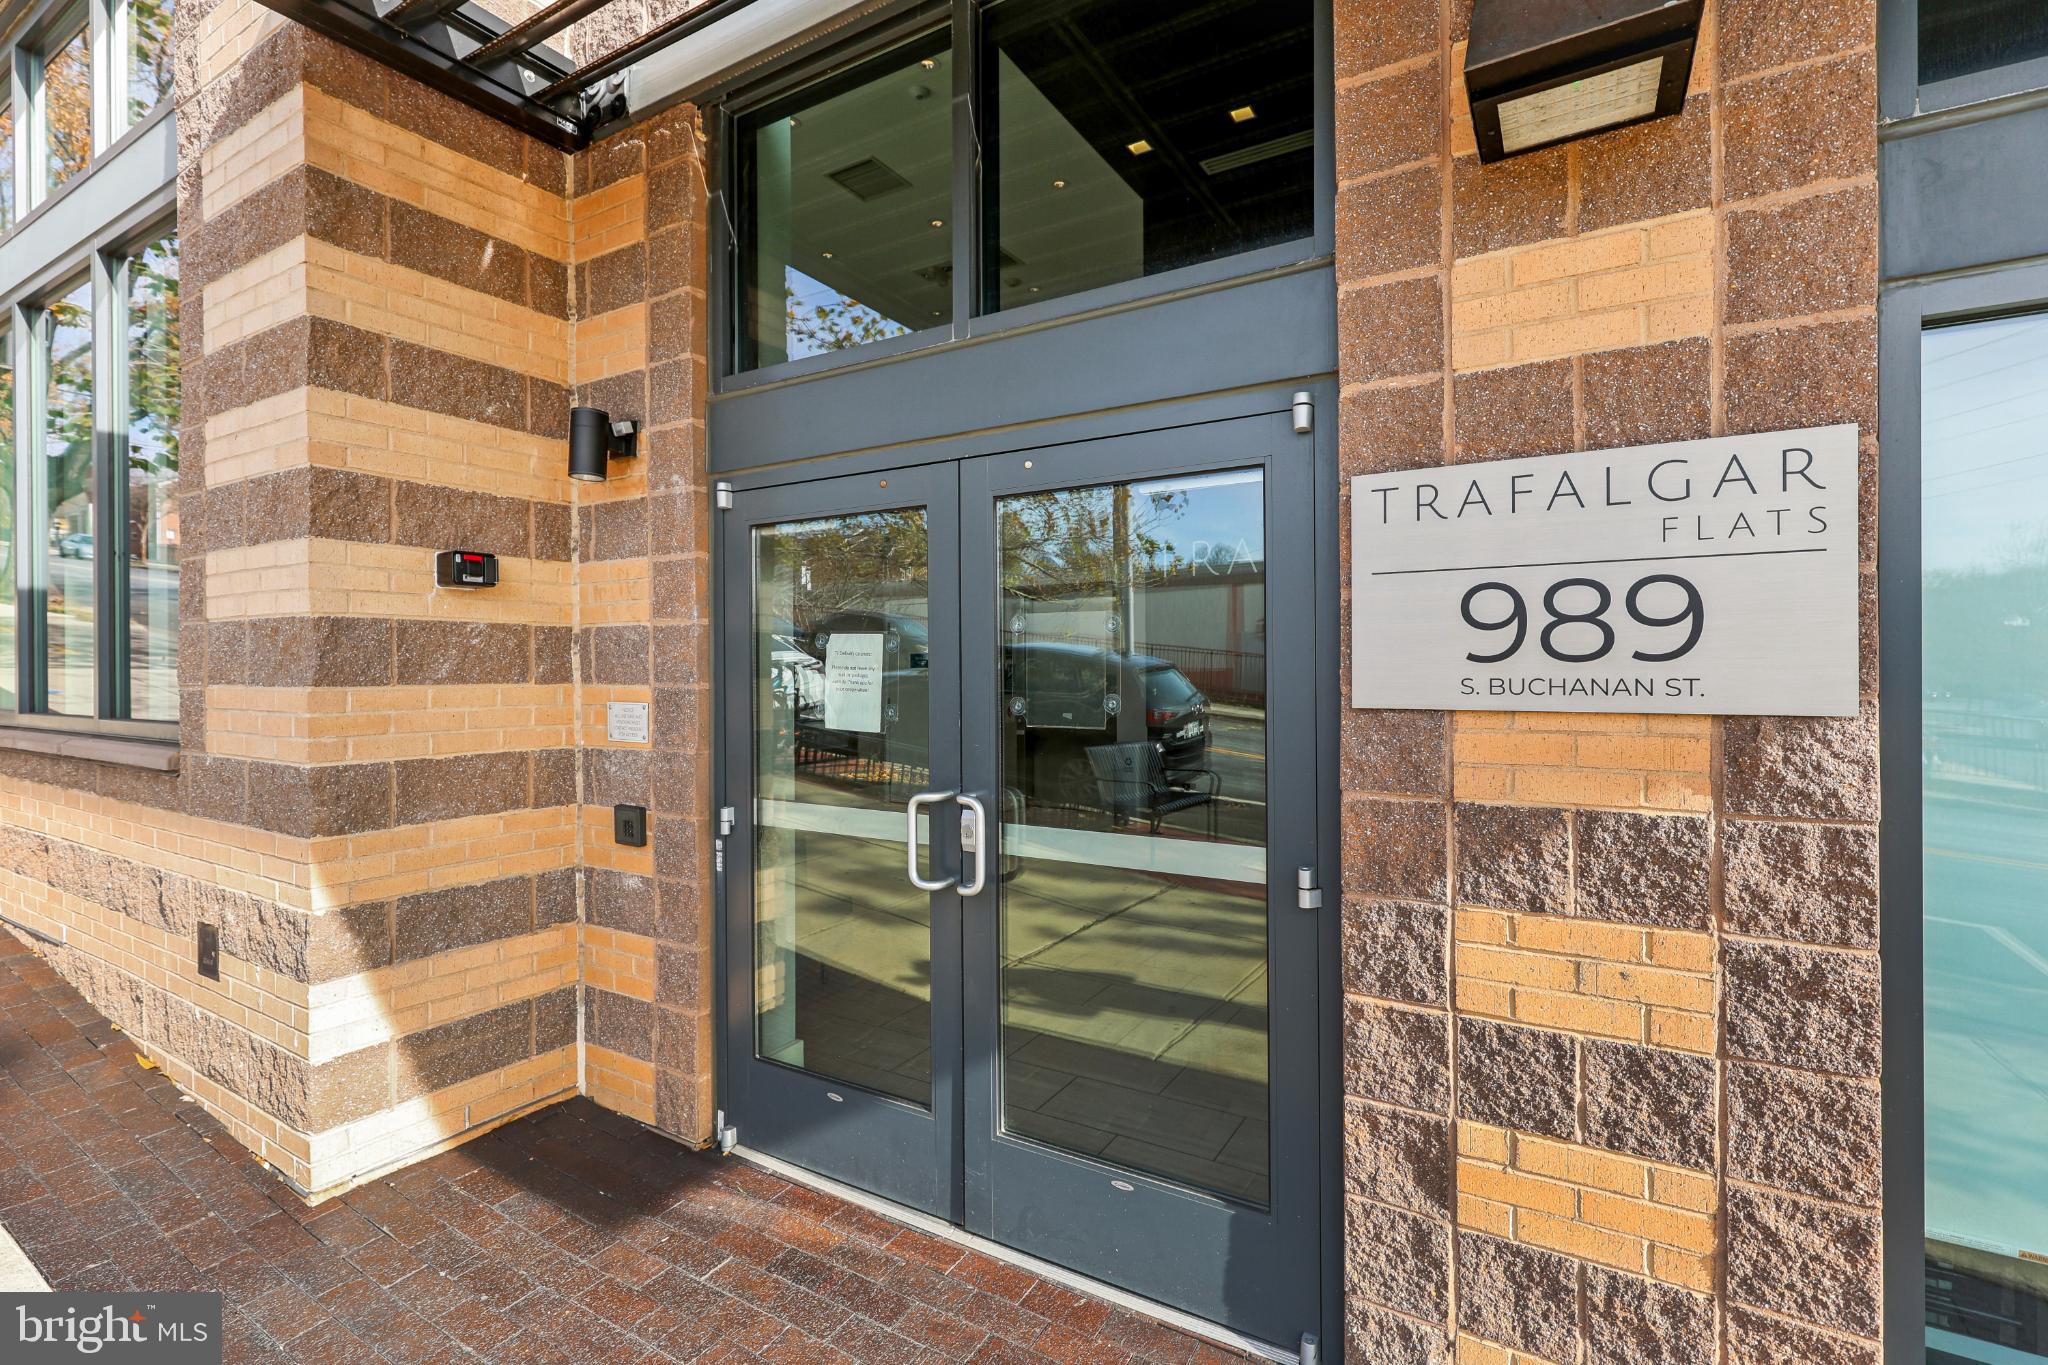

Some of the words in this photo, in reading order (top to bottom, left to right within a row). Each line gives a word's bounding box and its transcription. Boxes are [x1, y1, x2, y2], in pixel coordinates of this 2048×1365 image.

[1371, 447, 1827, 524] TRAFALGAR
[1661, 506, 1828, 543] FLATS
[1459, 573, 1705, 664] 989
[1460, 677, 1480, 696] S.
[1489, 677, 1653, 698] BUCHANAN
[1665, 678, 1705, 698] ST.
